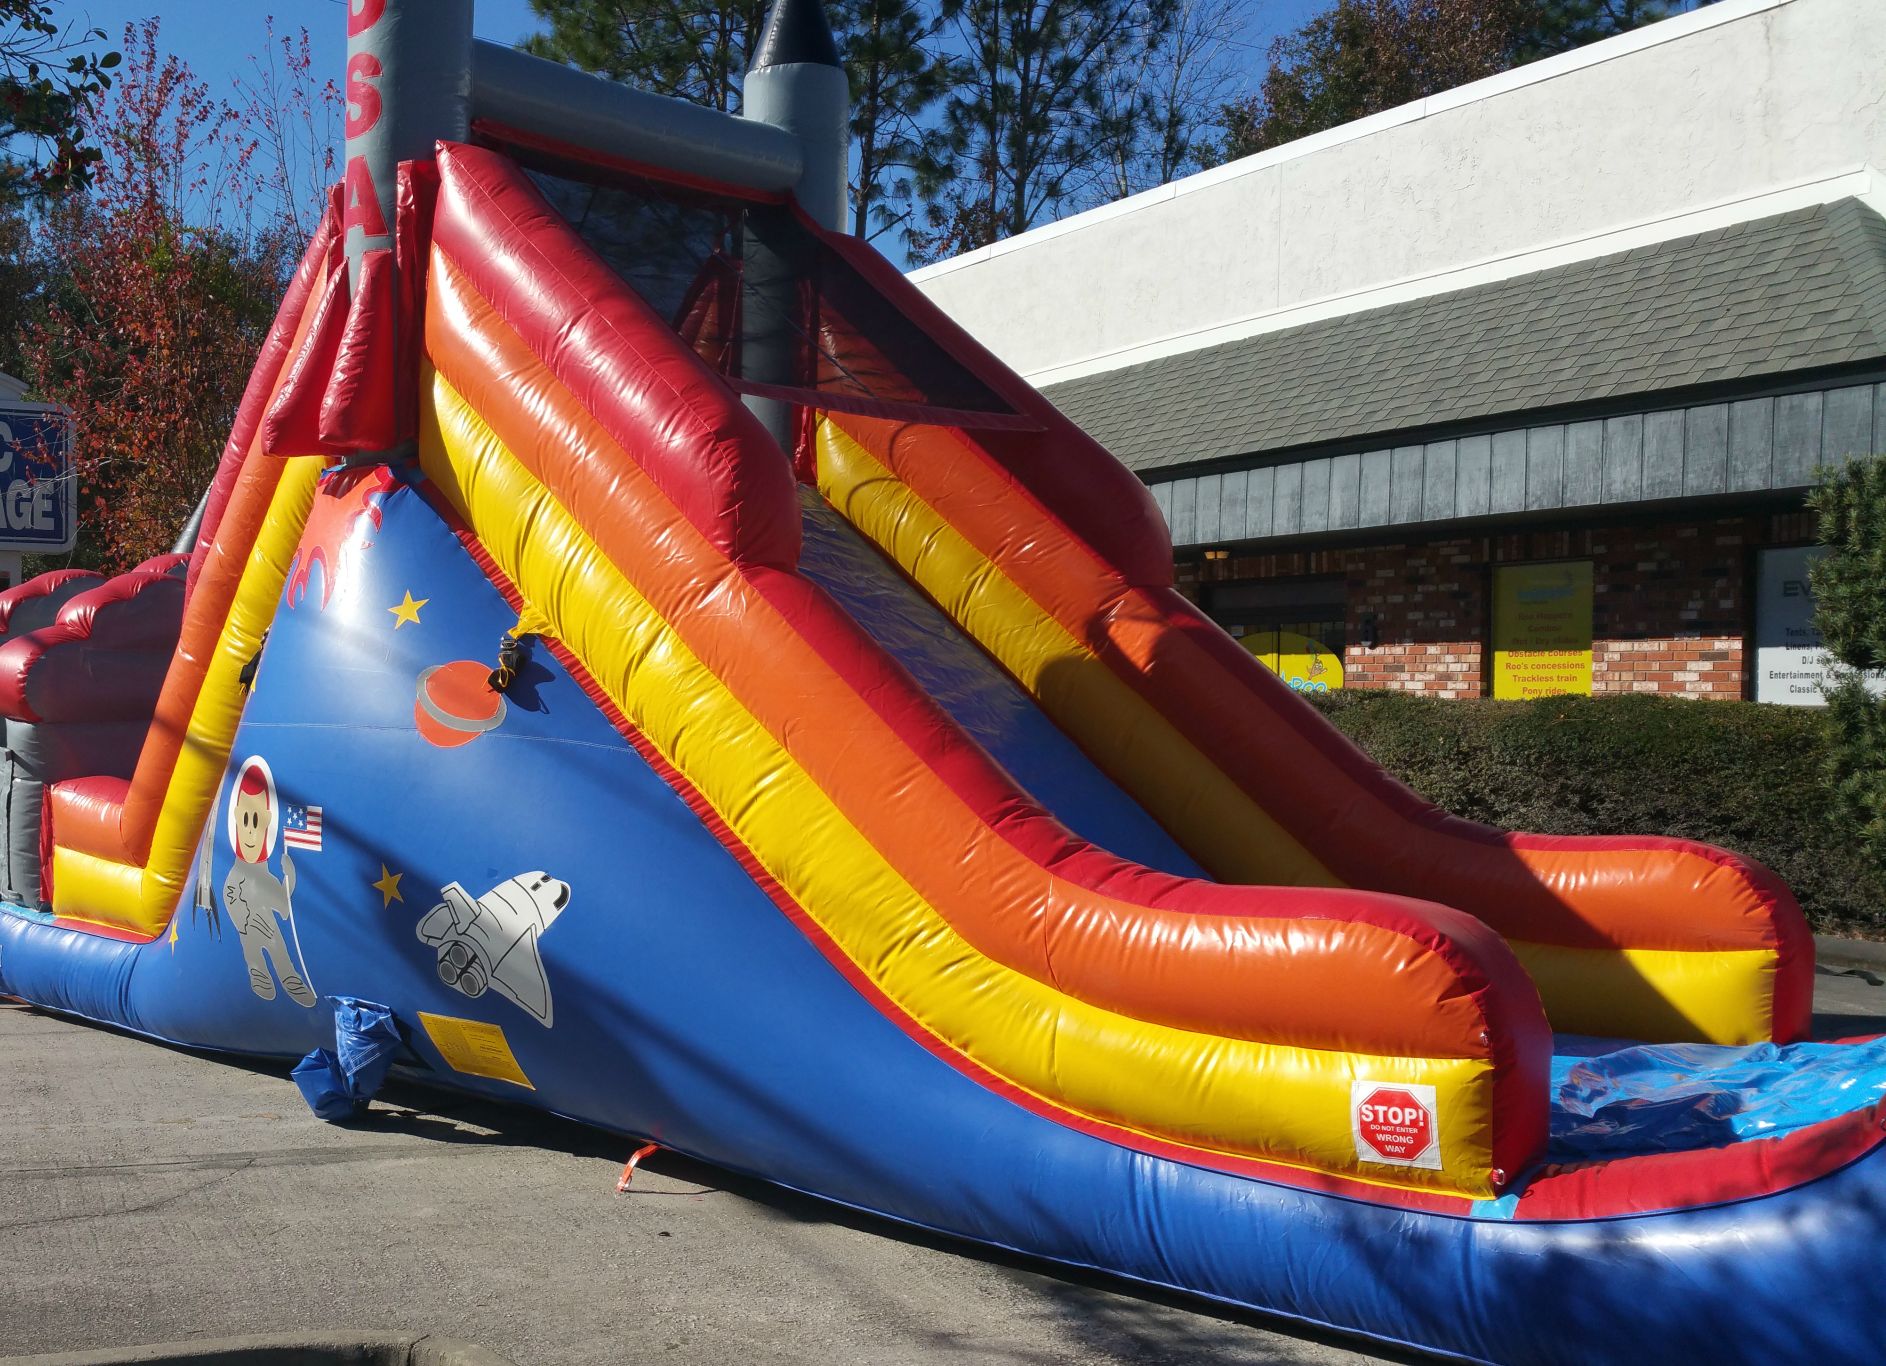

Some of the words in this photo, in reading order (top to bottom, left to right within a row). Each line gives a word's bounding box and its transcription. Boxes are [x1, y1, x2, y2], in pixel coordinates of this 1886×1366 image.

[1508, 648, 1545, 657] Obstacle
[1548, 649, 1584, 657] courses
[1505, 662, 1529, 670] Roo's
[1531, 661, 1585, 670] concessions
[1512, 674, 1554, 683] Trackless
[1557, 674, 1577, 682] train
[1769, 670, 1823, 679] Entertainment
[1522, 686, 1542, 696] Pony
[1545, 686, 1568, 695] rides
[1789, 684, 1817, 694] Classic
[1361, 1104, 1425, 1127] STOP!
[1396, 1126, 1418, 1134] ENTER
[1376, 1133, 1414, 1145] WRONG
[1385, 1144, 1406, 1154] WAY
